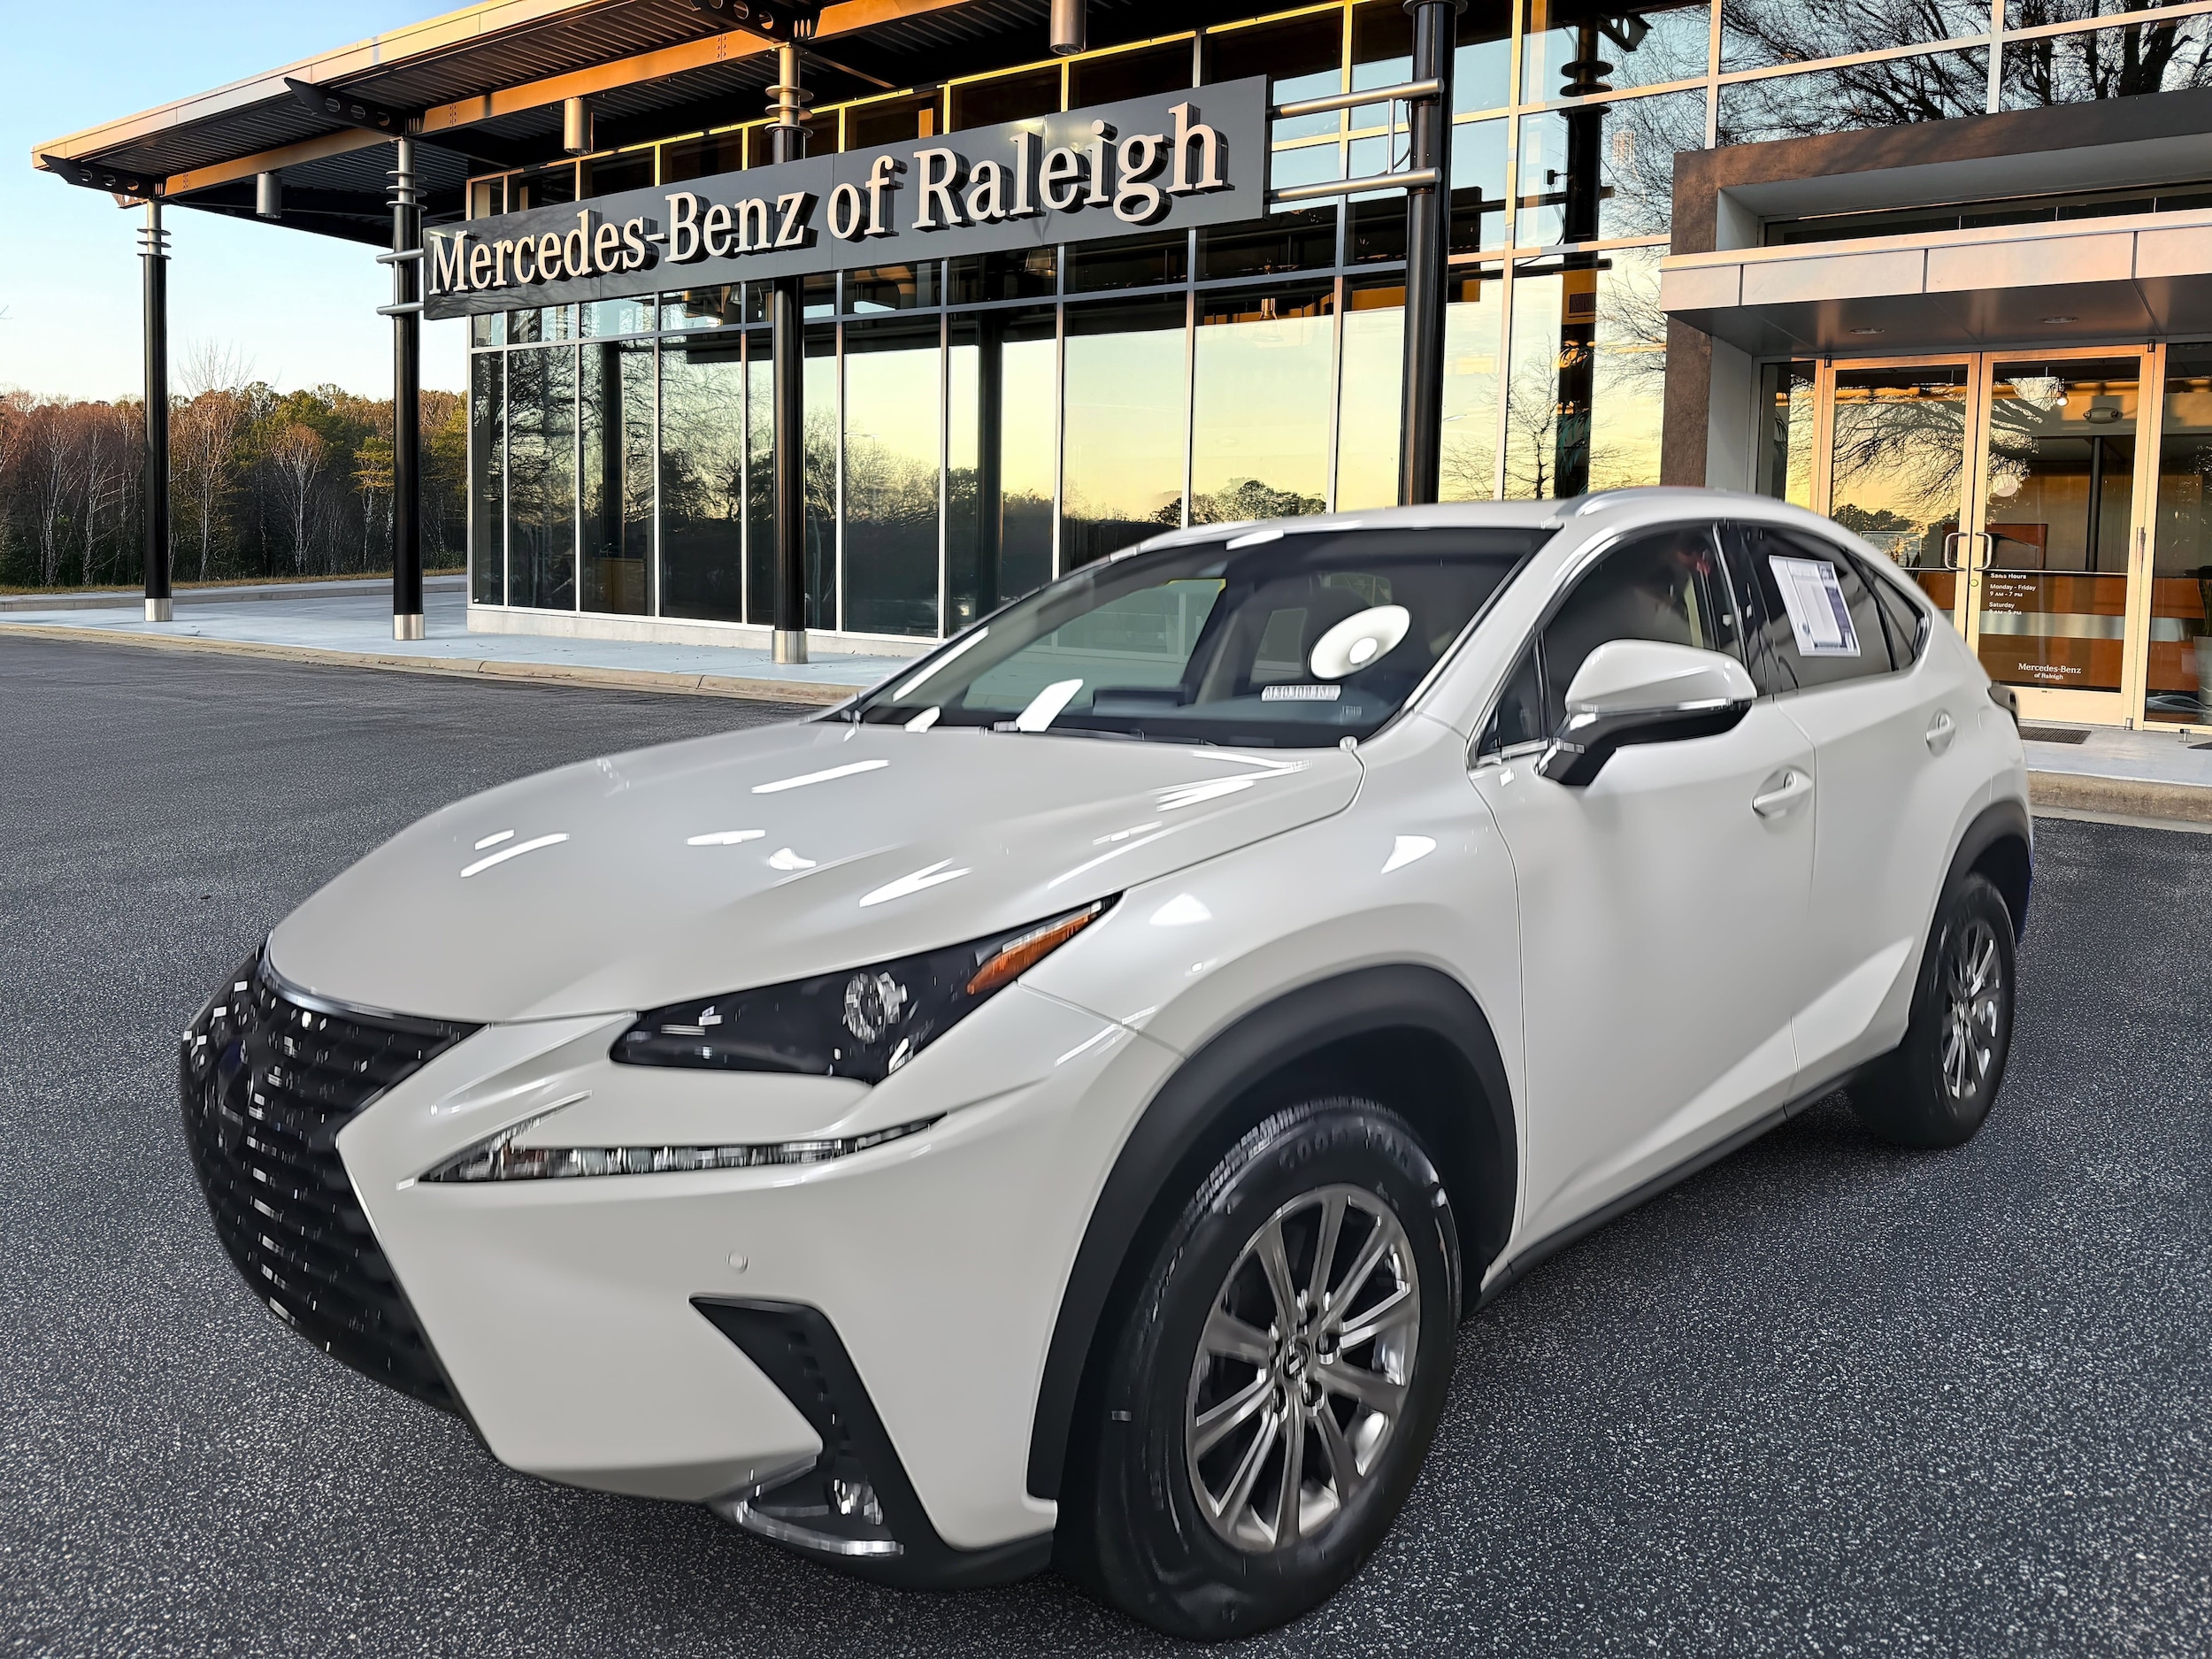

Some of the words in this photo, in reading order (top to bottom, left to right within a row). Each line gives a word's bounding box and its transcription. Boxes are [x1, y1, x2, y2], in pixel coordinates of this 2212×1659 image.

[429, 191, 807, 295] Mercedes-Benz
[827, 156, 896, 239] of
[912, 101, 1224, 224] Raleigh
[2018, 663, 2081, 673] Mercedes-Benz
